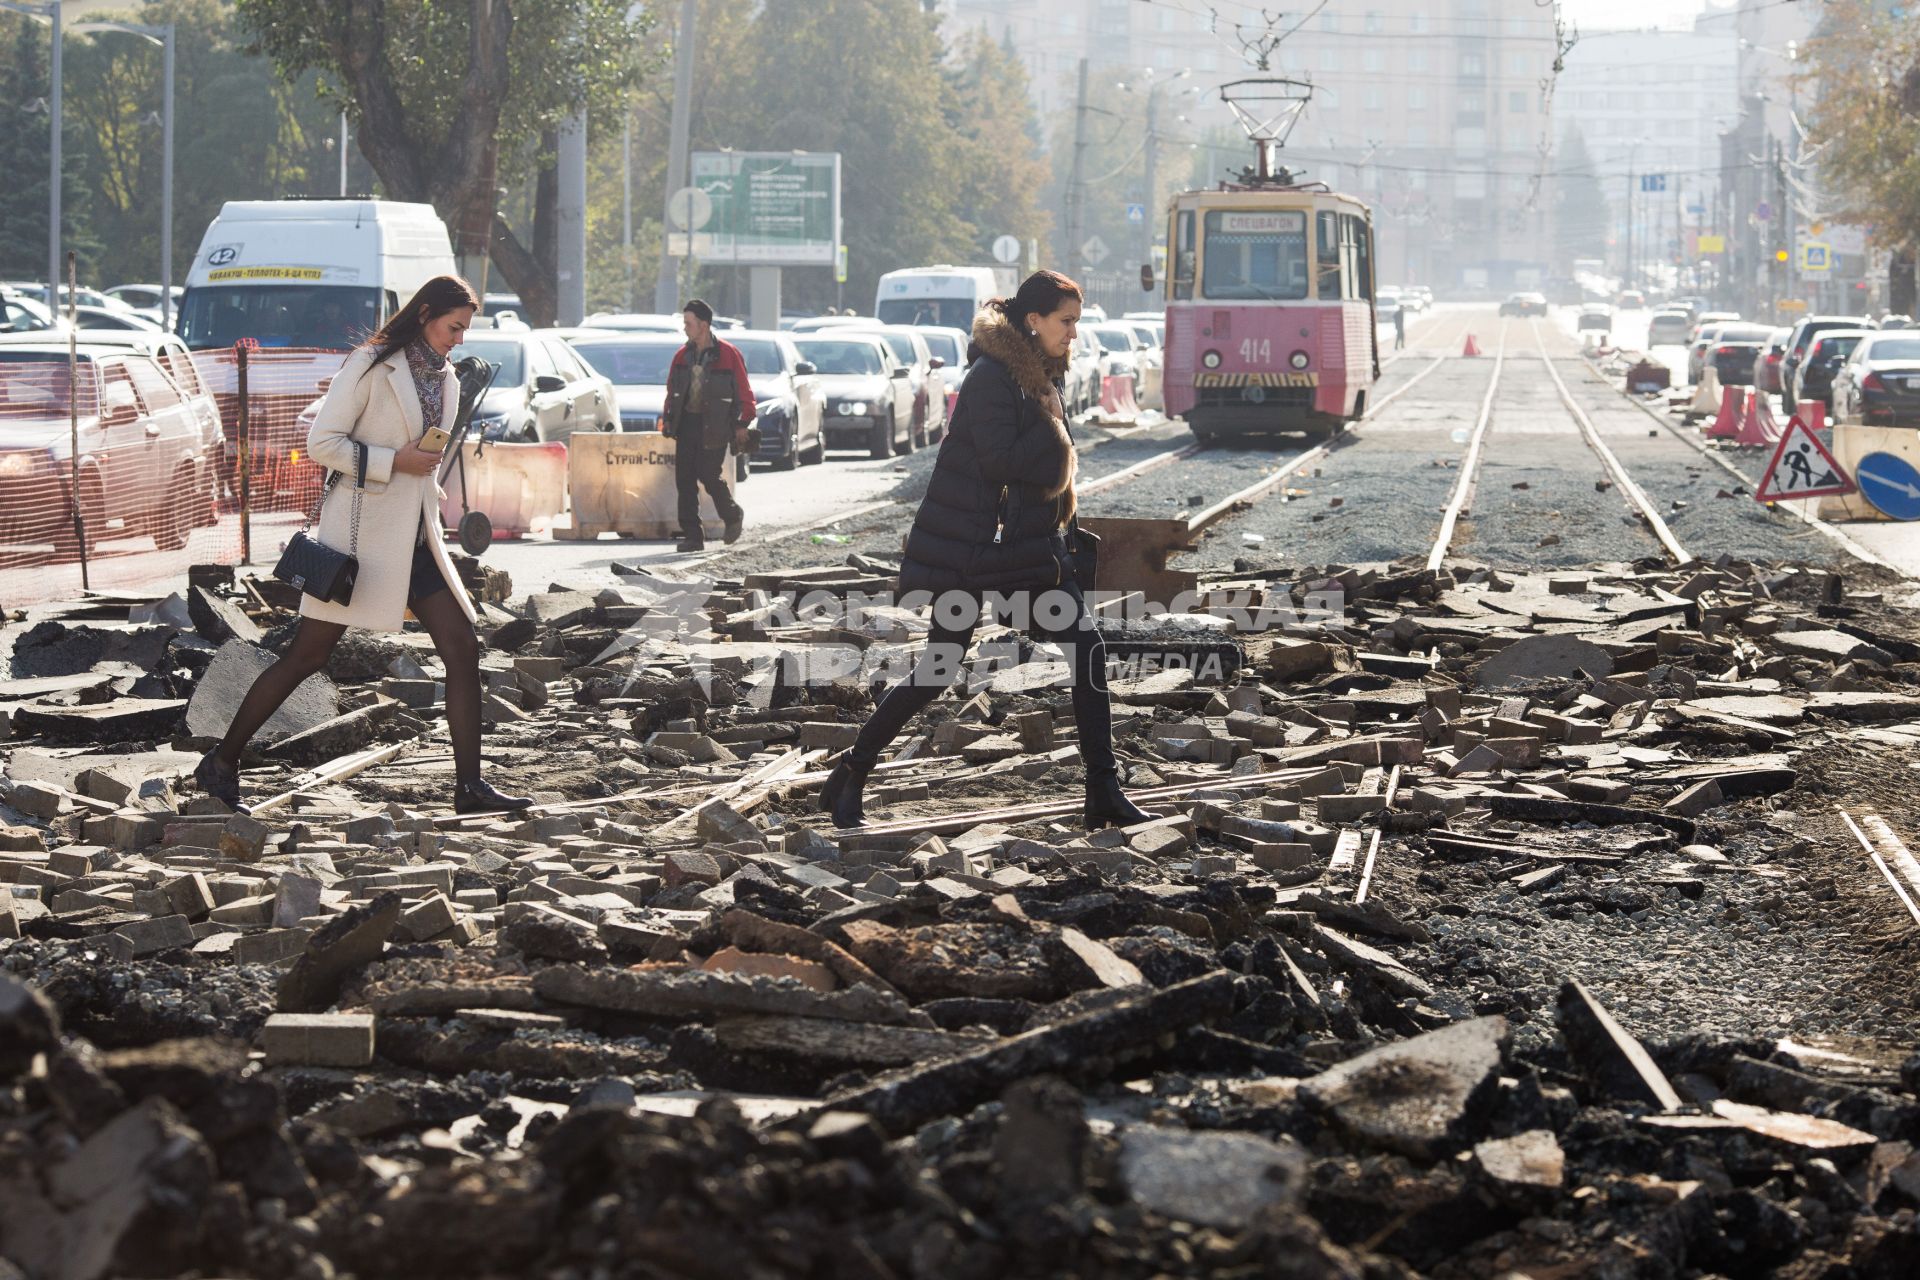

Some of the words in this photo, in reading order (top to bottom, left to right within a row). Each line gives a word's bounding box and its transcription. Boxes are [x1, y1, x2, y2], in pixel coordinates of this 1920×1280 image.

[1230, 216, 1294, 229] СПЕЦВАГОН
[210, 249, 234, 263] 42
[1239, 337, 1271, 364] 414
